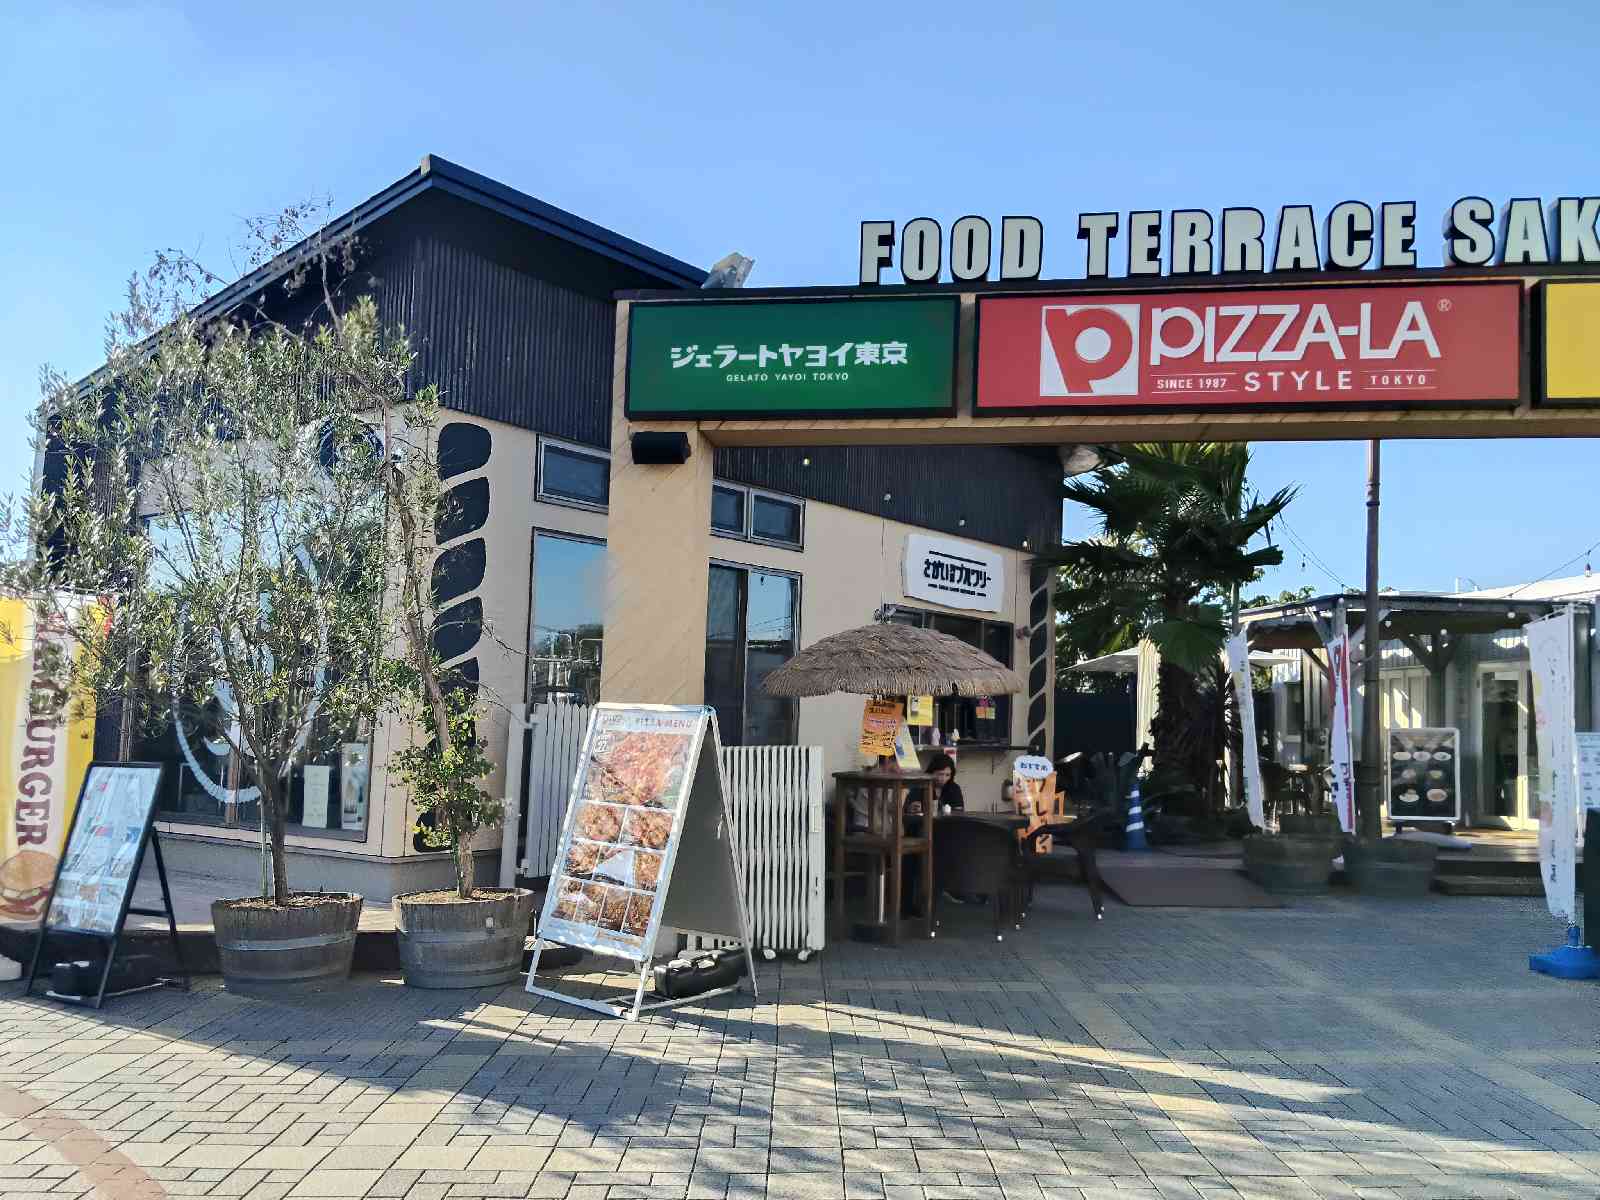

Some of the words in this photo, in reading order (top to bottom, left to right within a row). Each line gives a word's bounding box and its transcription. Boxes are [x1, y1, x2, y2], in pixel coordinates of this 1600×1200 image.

[859, 215, 1044, 285] FOOD
[1077, 201, 1417, 280] TERRACE
[1444, 196, 1600, 267] SAK
[671, 341, 908, 368] ジェラートヤヨイ東京
[726, 372, 768, 382] GELATO
[774, 371, 806, 381] YAYOI
[812, 371, 848, 381] TOKYO
[1157, 378, 1193, 389] SINCE
[1199, 378, 1227, 388] 1987
[1244, 371, 1353, 392] STYLE
[1371, 374, 1426, 385] TOKYO
